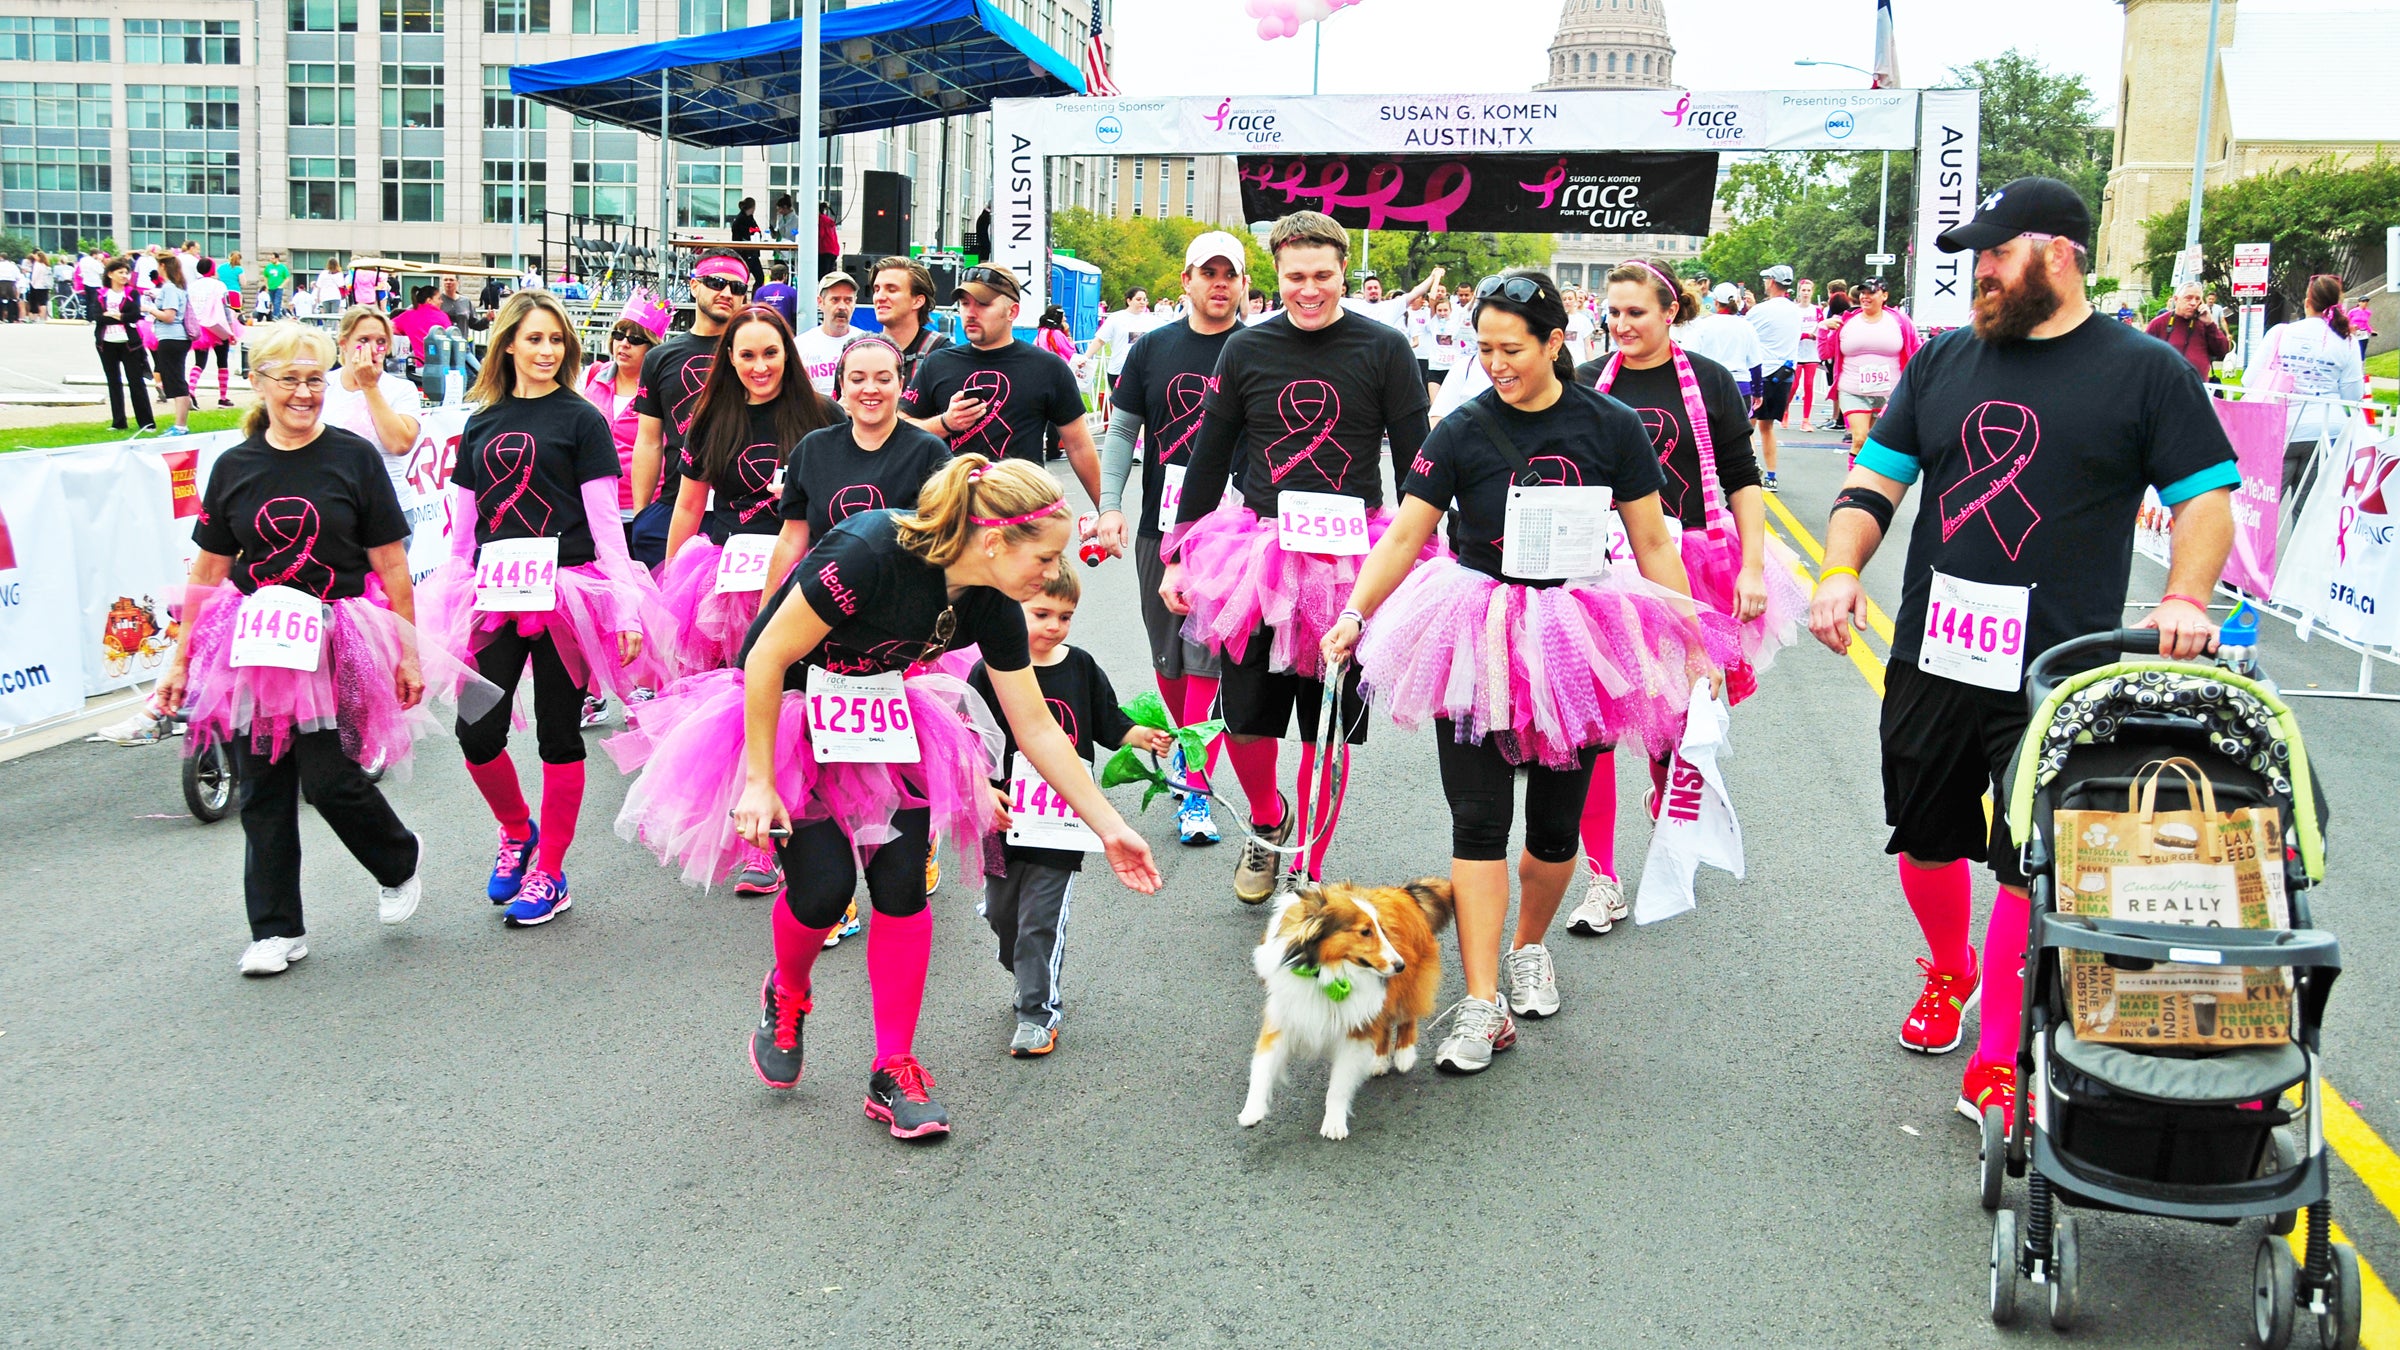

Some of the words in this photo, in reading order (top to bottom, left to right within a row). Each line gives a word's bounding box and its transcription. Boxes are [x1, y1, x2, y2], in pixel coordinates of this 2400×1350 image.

[1056, 103, 1115, 113] Presenting
[1118, 102, 1165, 112] Sponsor
[1782, 96, 1847, 107] Presenting
[1850, 96, 1902, 107] Sponsor
[1380, 105, 1449, 121] SUSAN
[1456, 105, 1476, 120] G.
[1483, 104, 1558, 120] KOMEN
[1687, 111, 1737, 127] race
[1098, 126, 1120, 134] DELL
[1228, 115, 1276, 131] race
[1828, 120, 1851, 128] DELL
[1561, 184, 1639, 209] race
[1934, 259, 1958, 297] TX
[1860, 371, 1890, 384] 10592
[1282, 511, 1364, 537] 12598
[721, 552, 768, 574] 125
[477, 559, 554, 588] 14464
[238, 609, 319, 643] 14466
[1927, 601, 2022, 656] 14469
[826, 676, 847, 684] race
[811, 694, 909, 733] 12596
[1012, 778, 1080, 819] 144
[2219, 831, 2254, 847] LAX
[2154, 853, 2201, 863] BURGER
[2077, 894, 2108, 903] BLACK
[2128, 897, 2221, 912] REALLY
[2077, 903, 2110, 913] LIMA
[2088, 965, 2099, 1007] MAINE
[2101, 965, 2113, 995] LIVE
[2076, 965, 2087, 1020] LOBSTER
[2120, 993, 2159, 1001] SCRATCH
[2181, 992, 2190, 1009] ALE
[2120, 1001, 2160, 1010] MADE
[2219, 1002, 2285, 1014] TRUFFLE
[2163, 995, 2176, 1039] INDIA
[2219, 1014, 2287, 1026] TREMOR
[2120, 1029, 2144, 1038] INK
[2181, 1014, 2190, 1038] PALE
[2221, 1026, 2288, 1039] QUES
